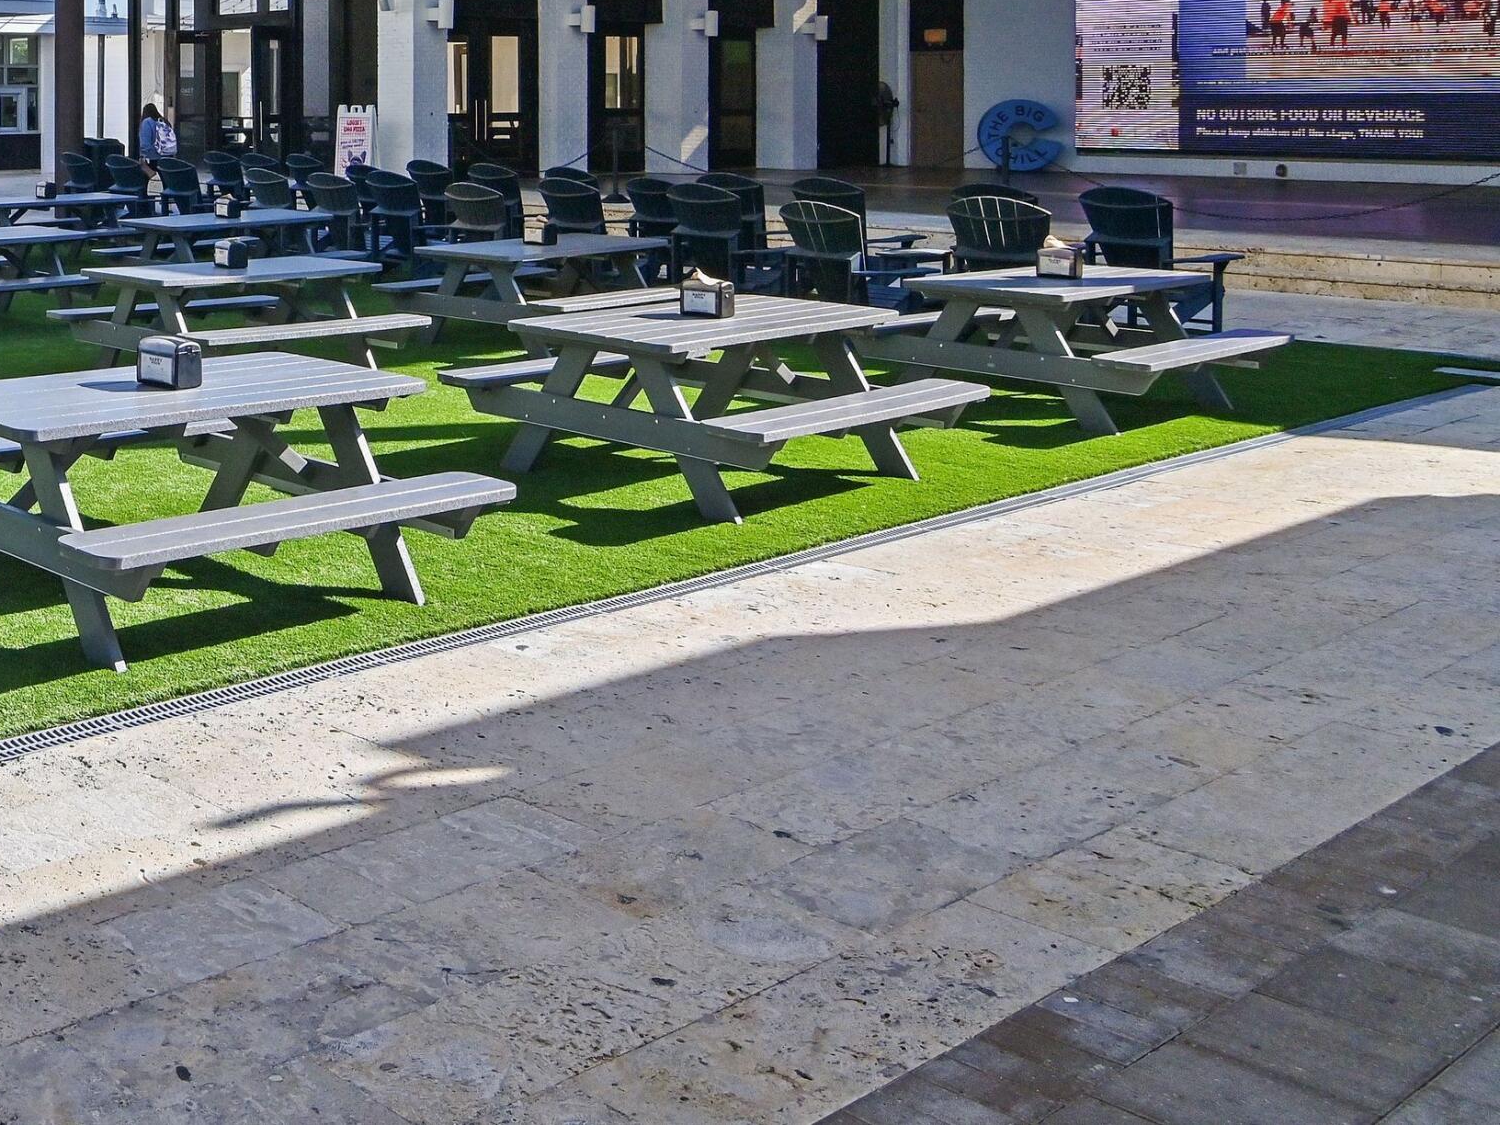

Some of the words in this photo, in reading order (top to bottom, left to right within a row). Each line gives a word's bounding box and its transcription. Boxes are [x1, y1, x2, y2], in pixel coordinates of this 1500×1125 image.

[1196, 109, 1216, 121] NO
[1219, 109, 1278, 121] OUTSIDE
[1280, 109, 1318, 121] FOOD
[1322, 109, 1343, 122] OR
[1346, 110, 1426, 122] BEVERAGE
[987, 111, 1009, 140] THE
[1014, 105, 1045, 123] BIG
[1358, 129, 1396, 138] THANK
